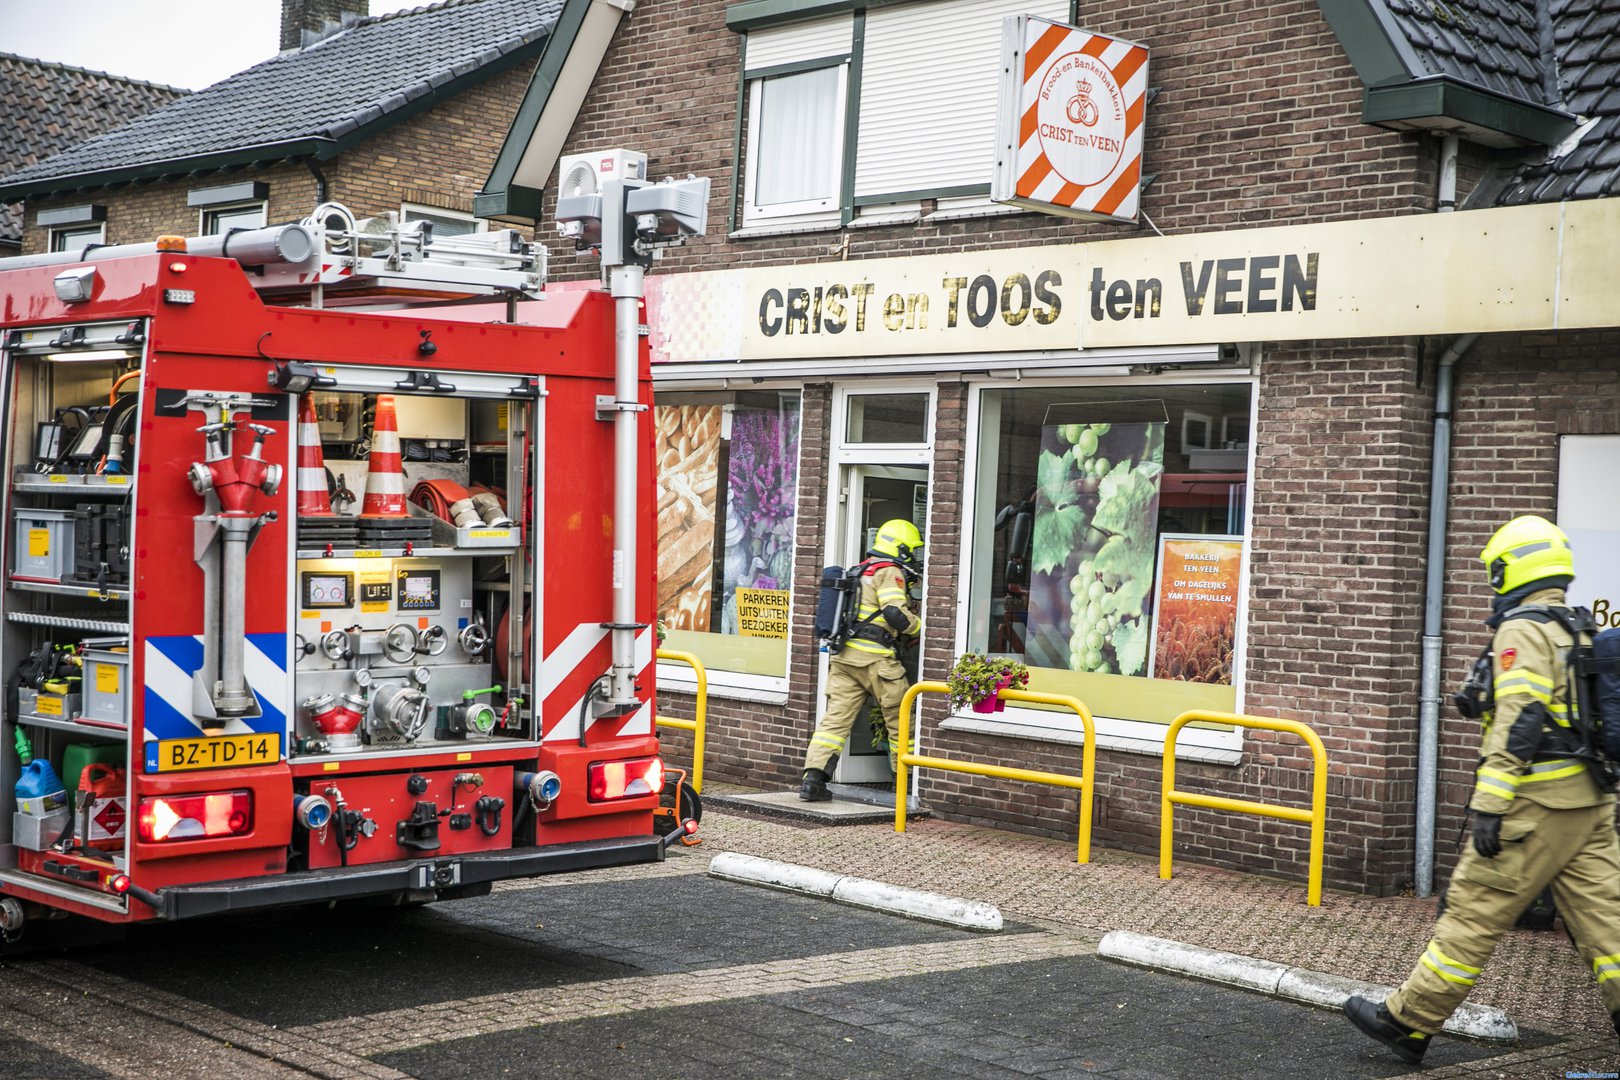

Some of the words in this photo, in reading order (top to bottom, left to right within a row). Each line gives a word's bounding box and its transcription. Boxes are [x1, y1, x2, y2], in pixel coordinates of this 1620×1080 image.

[1074, 57, 1123, 121] Banketbakkerij
[1040, 123, 1073, 143] CRIST
[1074, 136, 1089, 146] TEN
[1089, 134, 1120, 153] VEEN
[759, 283, 875, 337] CRIST
[882, 292, 929, 331] en
[942, 269, 1062, 328] TOOS
[1089, 267, 1163, 321] ten
[1179, 252, 1320, 316] VEEN
[1184, 553, 1219, 563] BAKKERIJ
[1200, 565, 1220, 573] VEEN
[1188, 581, 1227, 590] DAGELIJKS
[743, 593, 789, 606] PARKEREN
[1196, 594, 1232, 602] SMULLEN
[147, 759, 158, 767] NL
[172, 739, 269, 766] BZ-TD-14
